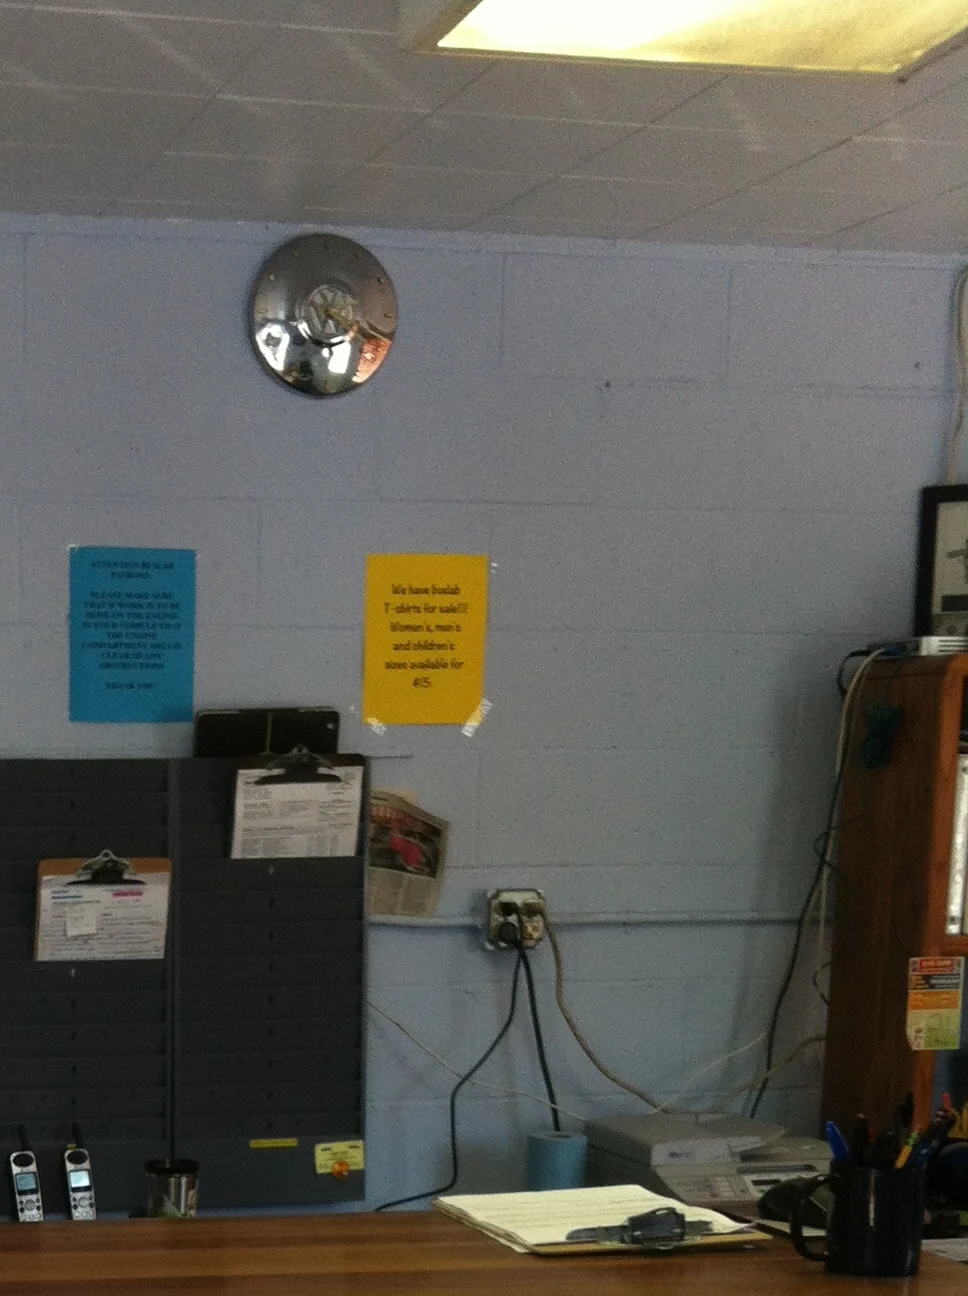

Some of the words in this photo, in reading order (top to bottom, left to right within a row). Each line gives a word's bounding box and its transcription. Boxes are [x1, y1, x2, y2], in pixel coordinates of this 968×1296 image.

[391, 583, 407, 595] We
[408, 583, 430, 595] have
[423, 602, 437, 614] for
[393, 639, 411, 651] and
[409, 658, 449, 670] available
[450, 657, 465, 670] for
